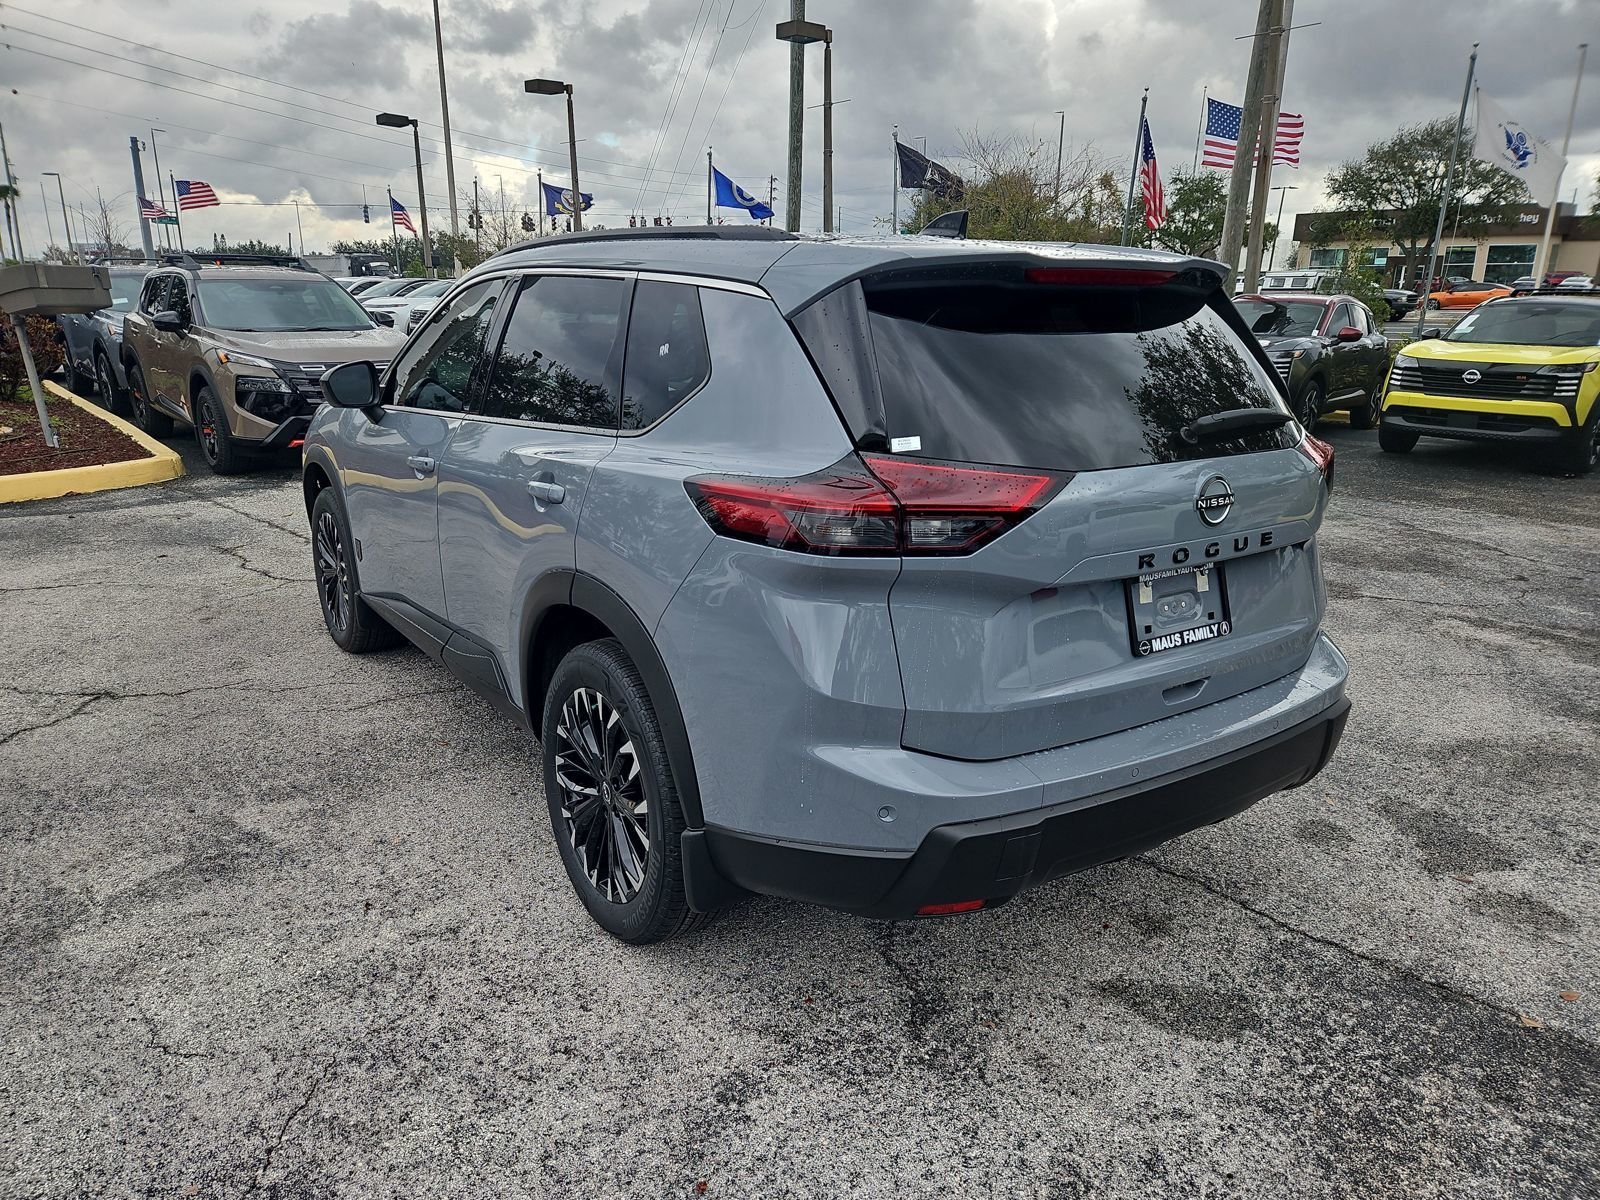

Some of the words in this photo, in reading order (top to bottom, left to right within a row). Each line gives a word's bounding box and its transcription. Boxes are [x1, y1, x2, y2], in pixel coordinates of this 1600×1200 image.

[1197, 495, 1235, 508] NISSAN
[1138, 531, 1274, 570] ROGUE
[1151, 633, 1182, 653] MAUS
[1183, 623, 1219, 644] FAMILY
